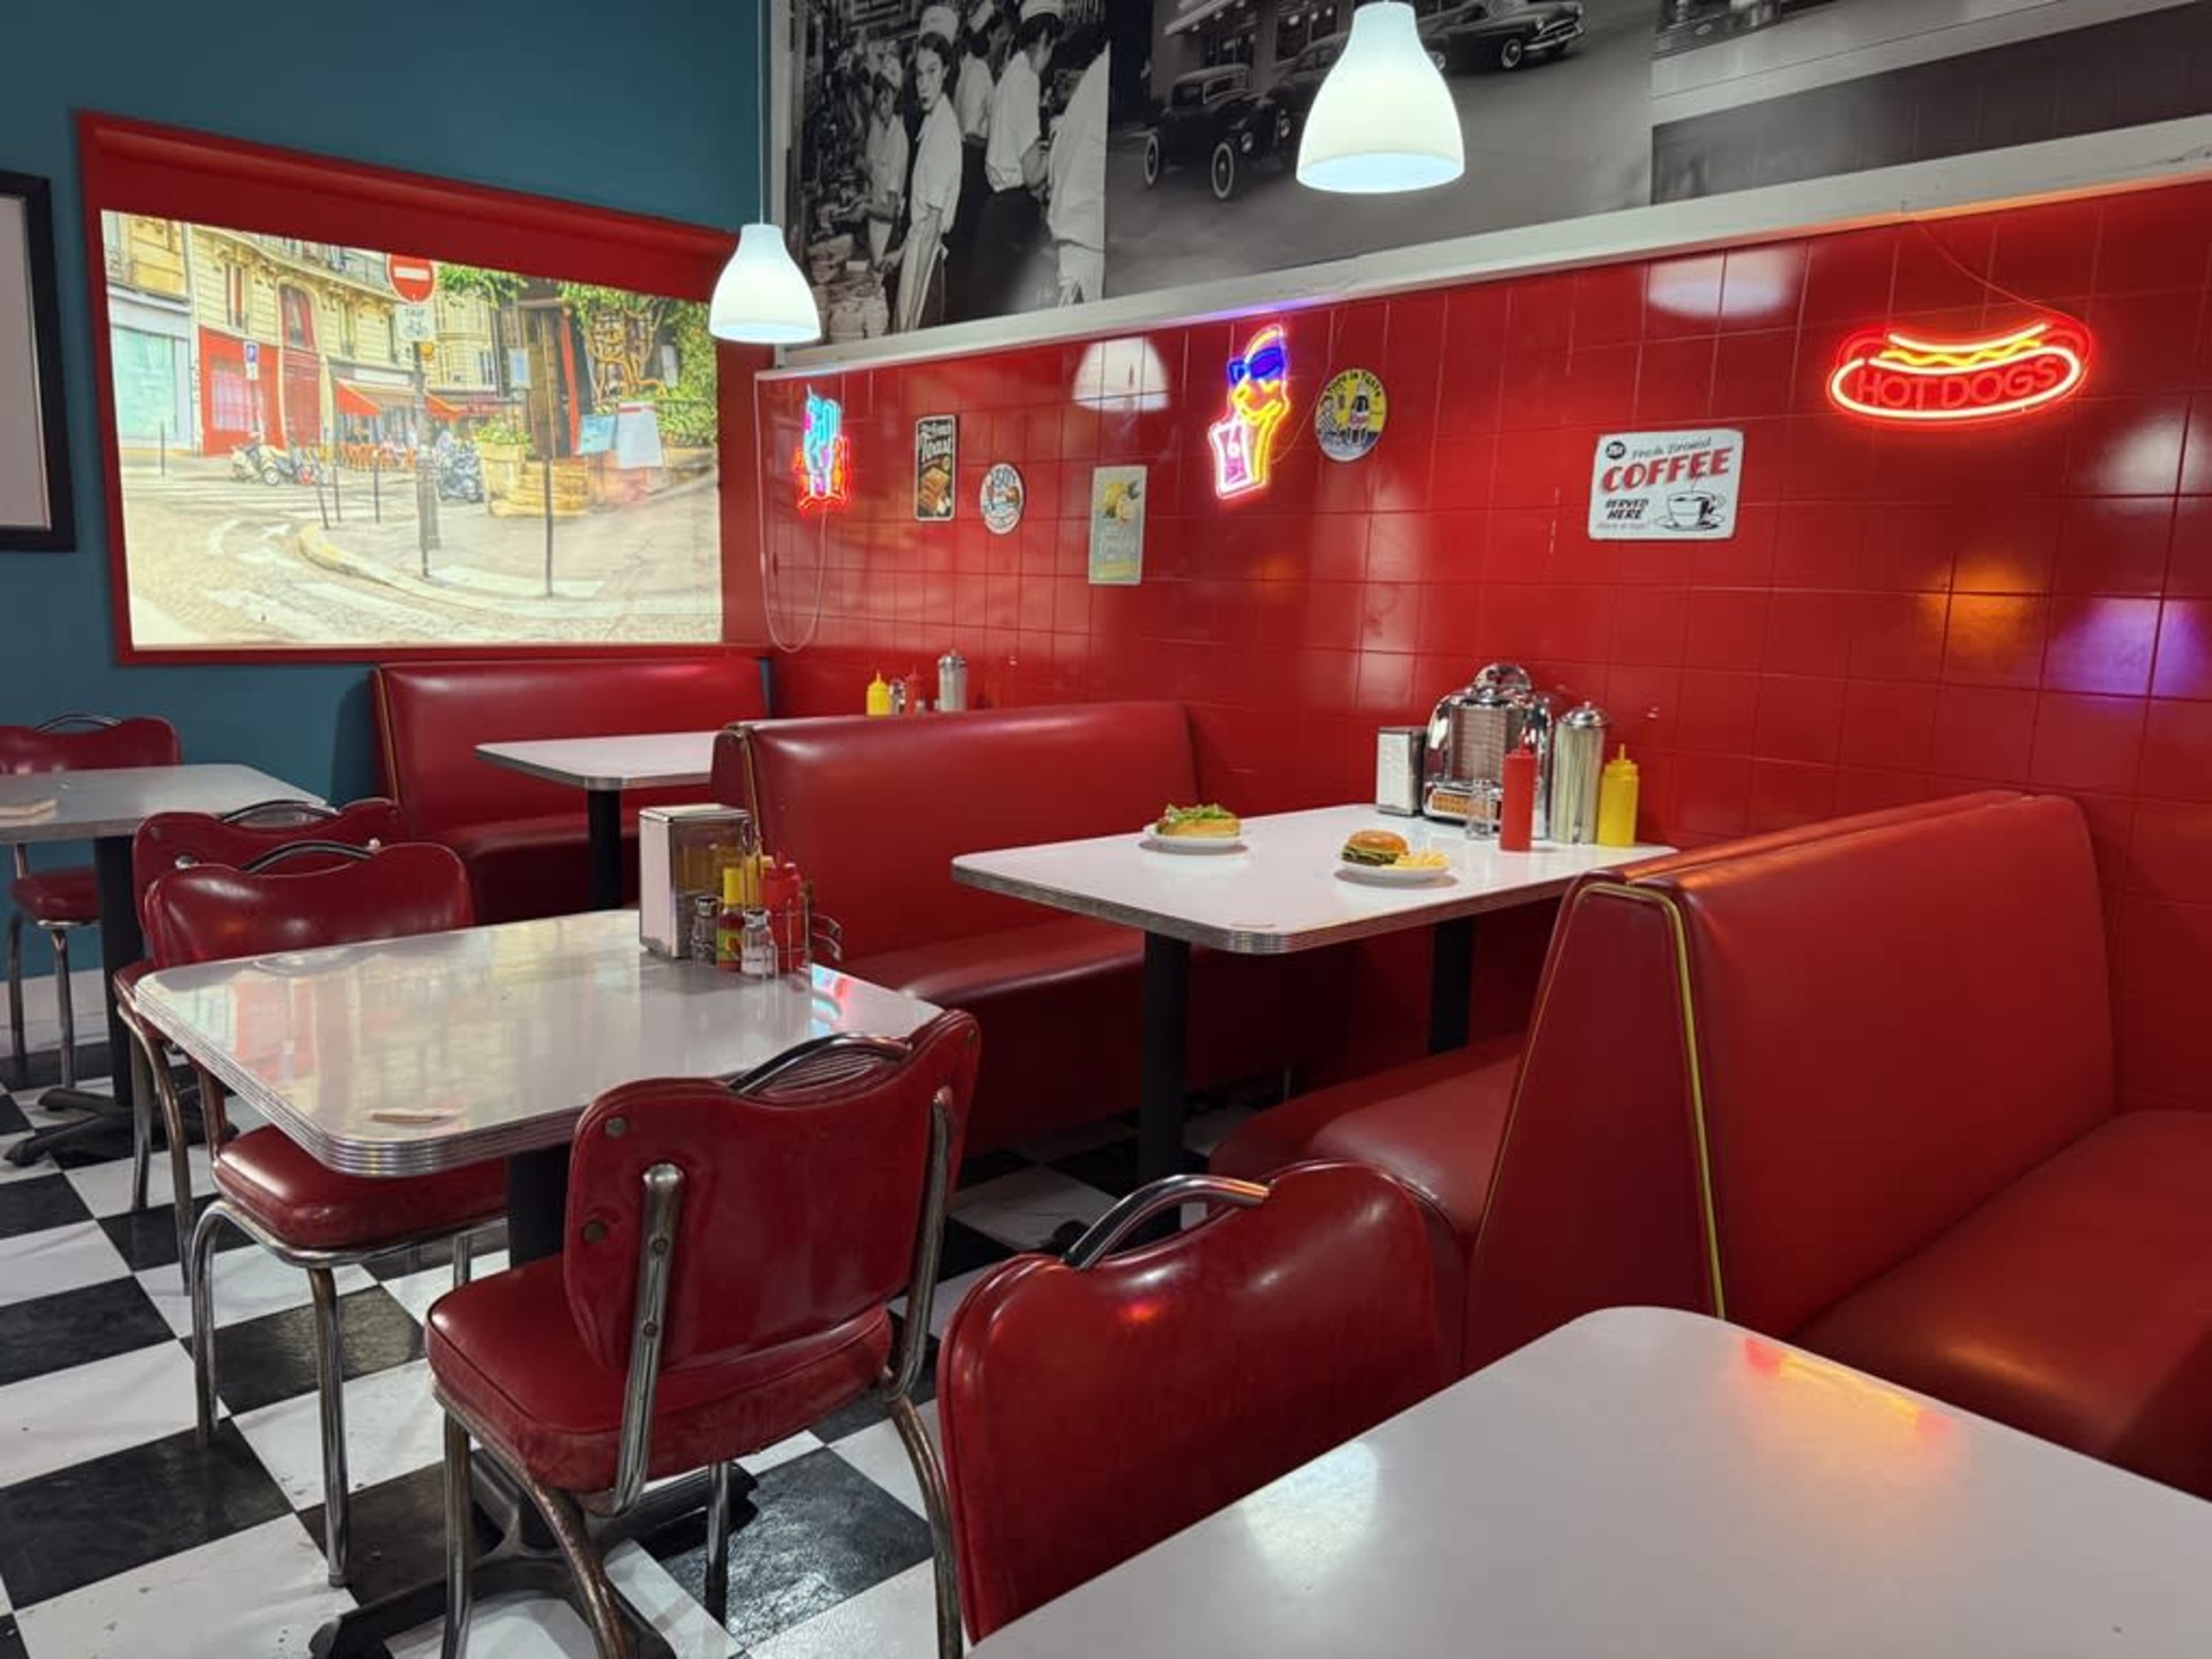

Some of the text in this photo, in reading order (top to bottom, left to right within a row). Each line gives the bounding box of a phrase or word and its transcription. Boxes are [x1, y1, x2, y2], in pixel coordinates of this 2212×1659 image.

[1855, 357, 2059, 410] HOT DOGS
[1601, 448, 1733, 492] COFFEE
[1605, 498, 1649, 509] SERVED
[1607, 509, 1641, 520] HERE
